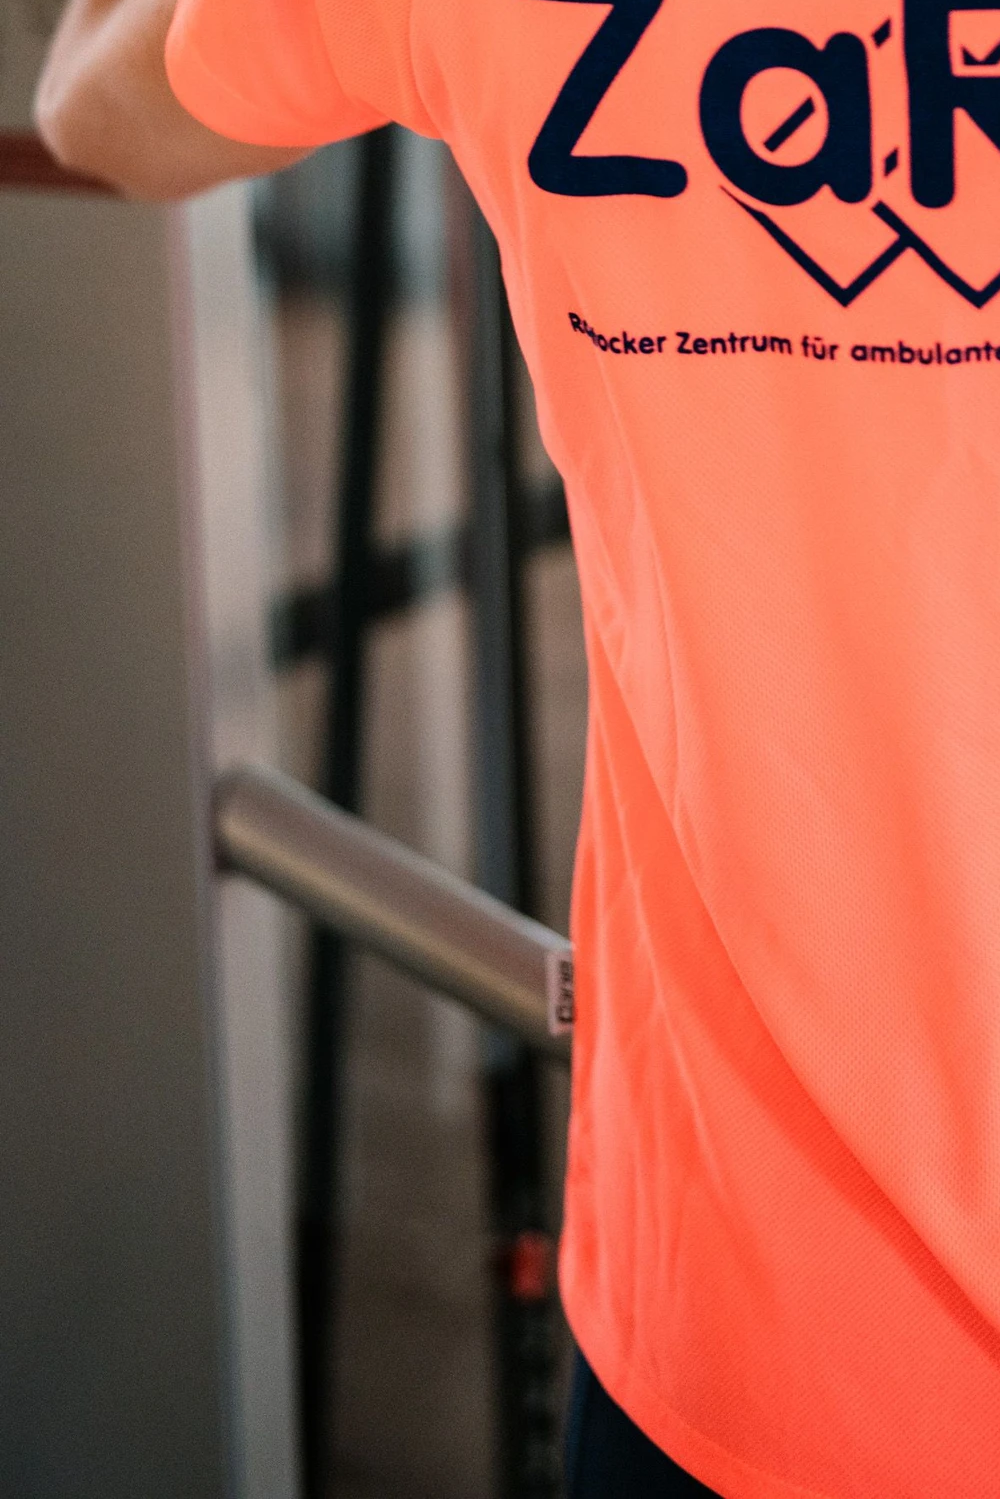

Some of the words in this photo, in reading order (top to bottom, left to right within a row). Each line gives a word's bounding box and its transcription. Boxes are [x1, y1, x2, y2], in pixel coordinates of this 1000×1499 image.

[568, 312, 666, 355] Rocker
[676, 332, 792, 355] Zentrum
[802, 336, 839, 360] für
